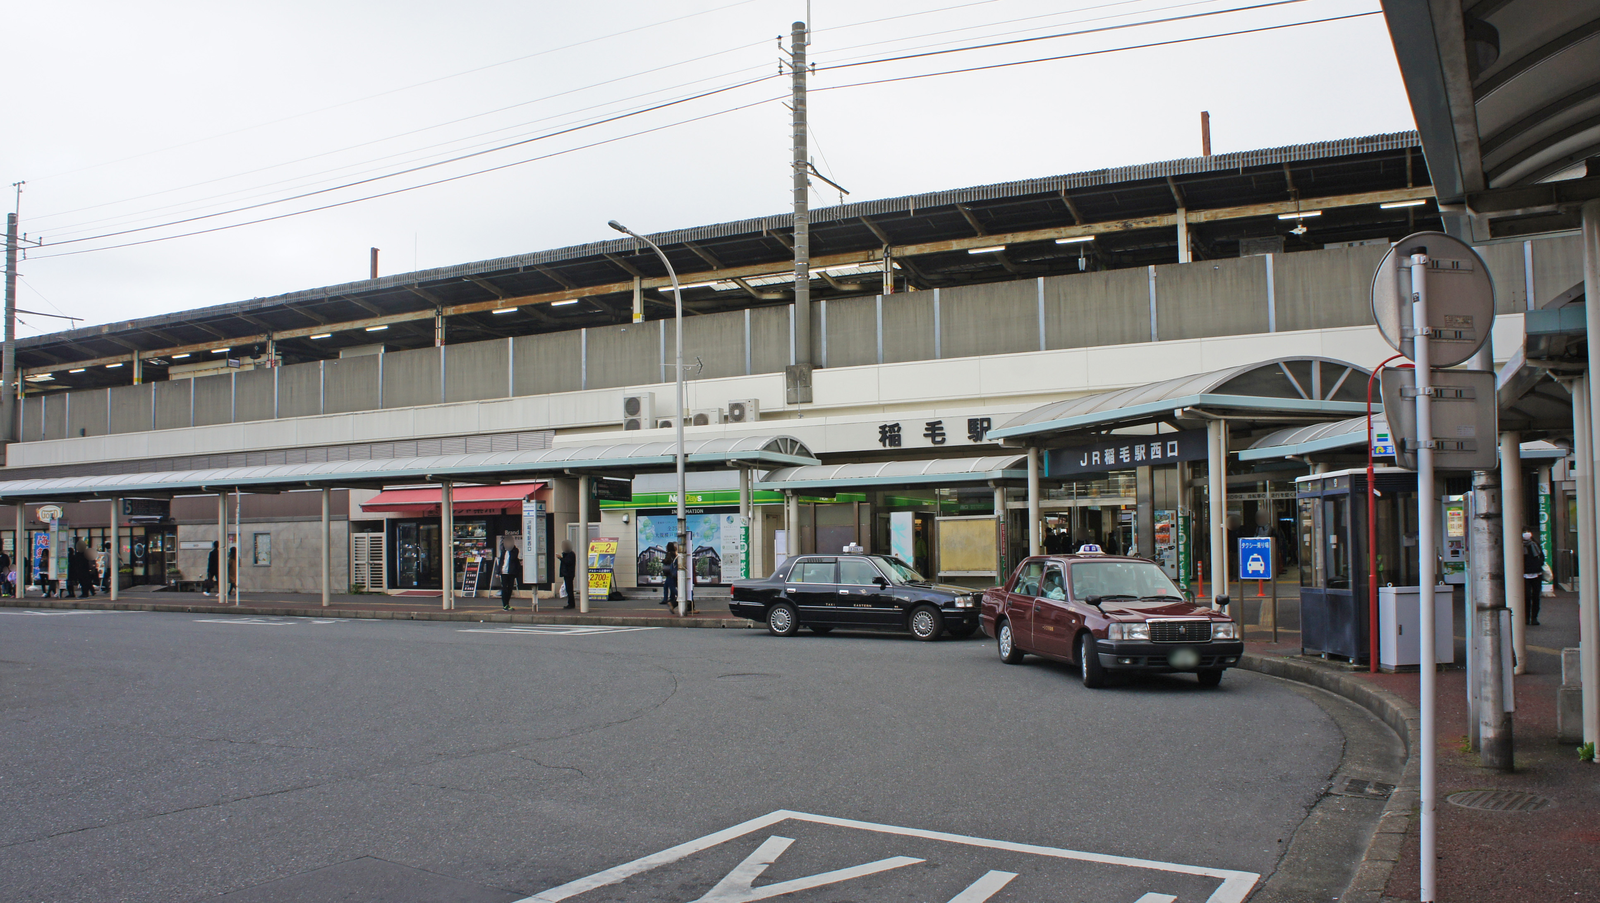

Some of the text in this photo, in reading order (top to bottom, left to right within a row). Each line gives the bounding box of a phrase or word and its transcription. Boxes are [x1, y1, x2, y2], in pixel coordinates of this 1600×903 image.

[879, 417, 992, 448] 稲毛駅
[1080, 440, 1179, 467] JR稲毛駅西口
[592, 481, 598, 497] 4
[125, 500, 132, 514] 5
[1241, 541, 1270, 549] タクシー乗り場
